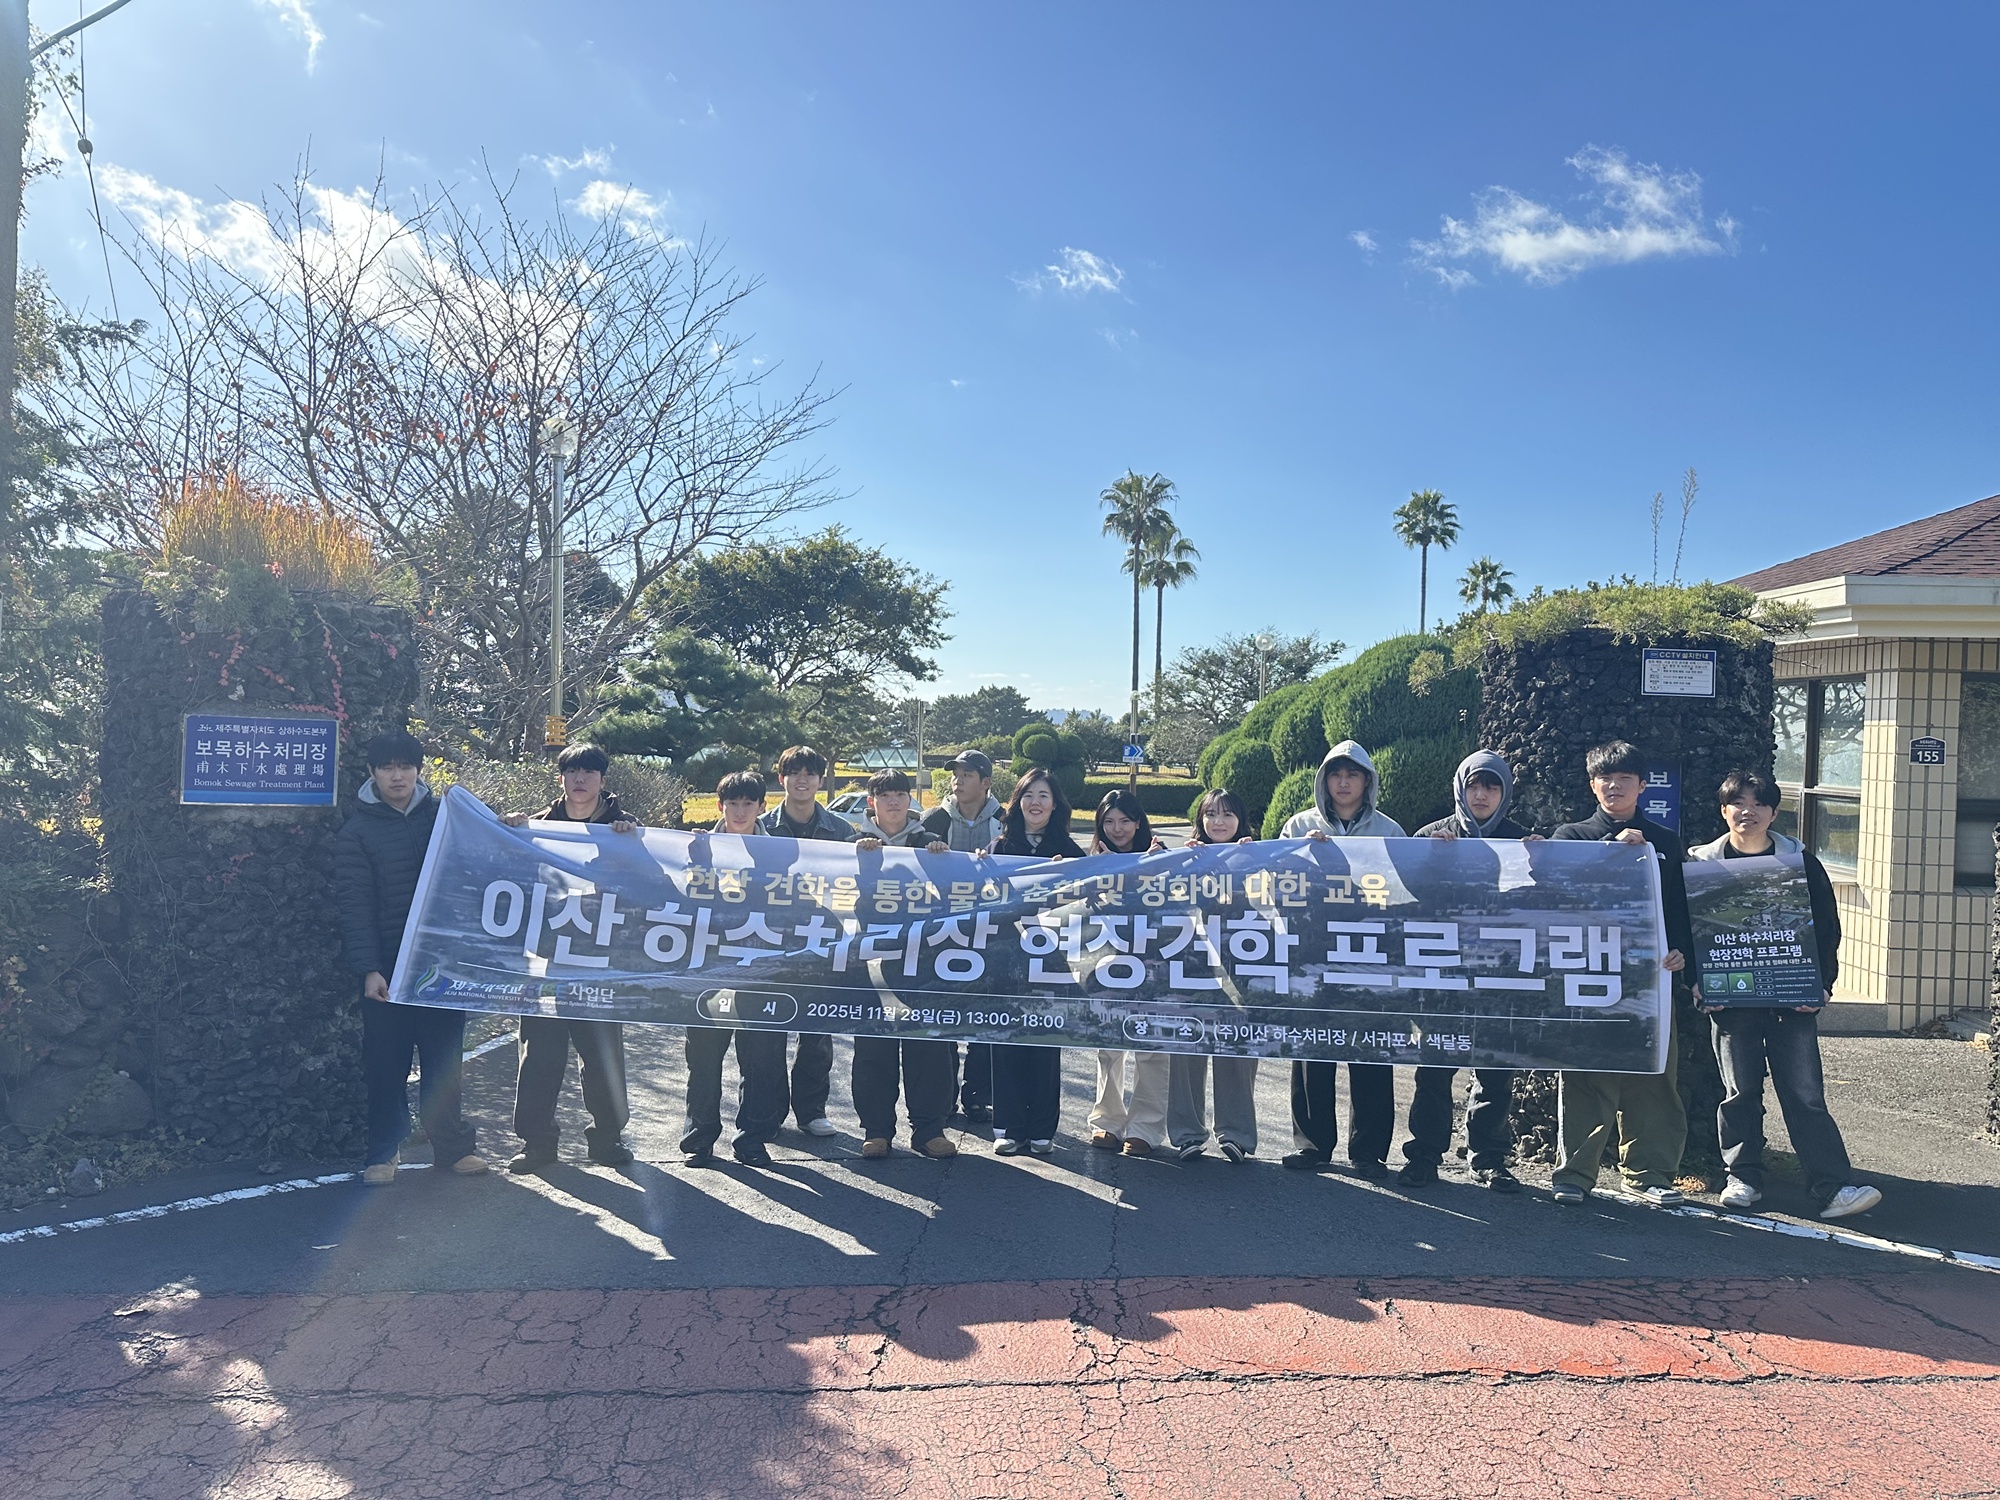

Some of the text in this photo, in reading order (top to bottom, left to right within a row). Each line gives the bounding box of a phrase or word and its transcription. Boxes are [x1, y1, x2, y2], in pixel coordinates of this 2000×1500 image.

[215, 724, 275, 735] 제주특별자치도
[278, 726, 328, 737] 상하수도본부
[195, 740, 328, 761] 보목하수처리장
[1917, 750, 1939, 762] 155
[194, 778, 325, 789] Bomok Sewage Treatment Plant
[689, 867, 752, 904] 현장
[764, 872, 860, 911] 견학을
[873, 879, 935, 914] 통한
[948, 881, 1009, 912] 물의
[1096, 873, 1124, 908] 및
[1136, 873, 1232, 907] 정화에
[1245, 869, 1311, 908] 대한
[1323, 873, 1391, 910] 교육
[481, 879, 1622, 1008] 이산 하수처리장 현장견학 프로그램
[1714, 929, 1796, 946] 이산 하수처리장
[1708, 944, 1803, 961] 현장견학 프로그램
[569, 985, 616, 1003] 사업단
[807, 1003, 863, 1020] 2025년
[867, 1005, 897, 1022] 11월
[900, 1008, 962, 1025] 28일(금)
[966, 1011, 1065, 1029] 13:00~18:00
[1213, 1023, 1270, 1042] (주)이산
[1273, 1026, 1348, 1046] 하수처리장
[1361, 1030, 1422, 1050] 서귀포시
[1426, 1033, 1473, 1051] 색달동
